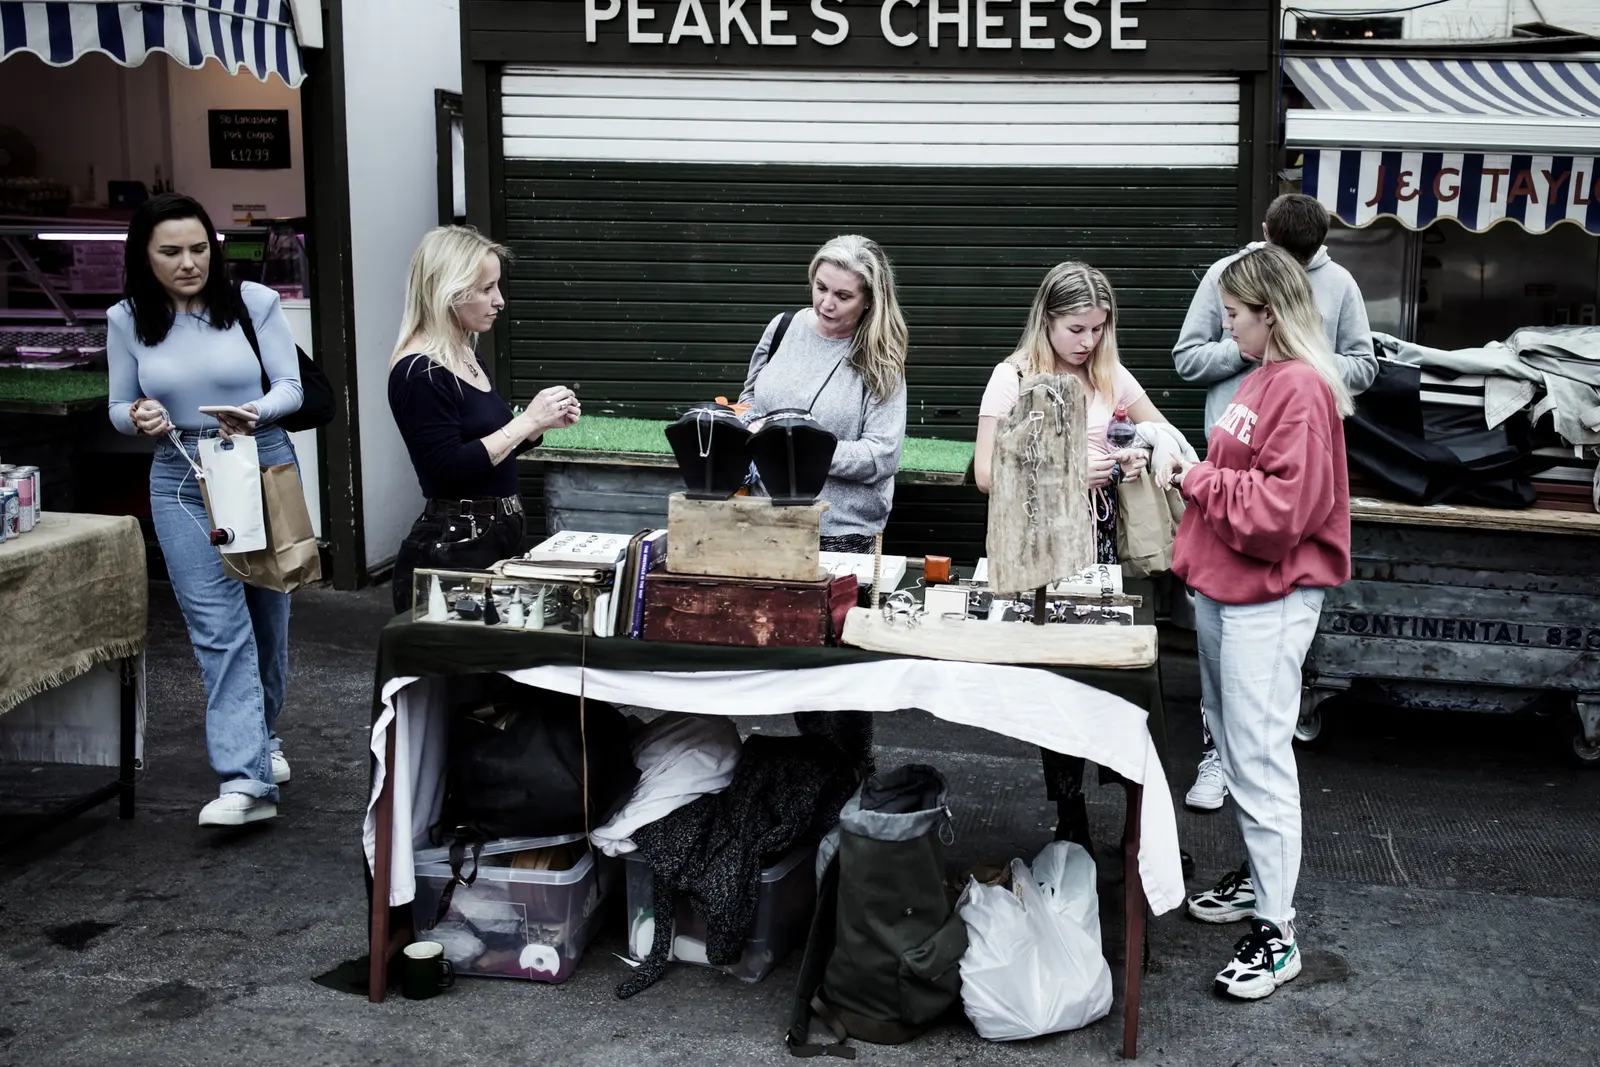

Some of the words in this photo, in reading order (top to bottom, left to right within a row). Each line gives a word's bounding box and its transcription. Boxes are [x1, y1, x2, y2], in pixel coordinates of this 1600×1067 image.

[880, 0, 1147, 50] CHEESE
[234, 113, 278, 125] Lancashire
[1365, 165, 1386, 208] J
[1395, 171, 1423, 202] &
[1433, 167, 1460, 202] G
[1481, 168, 1600, 206] TAYL
[1331, 613, 1530, 645] CONTINENTAL
